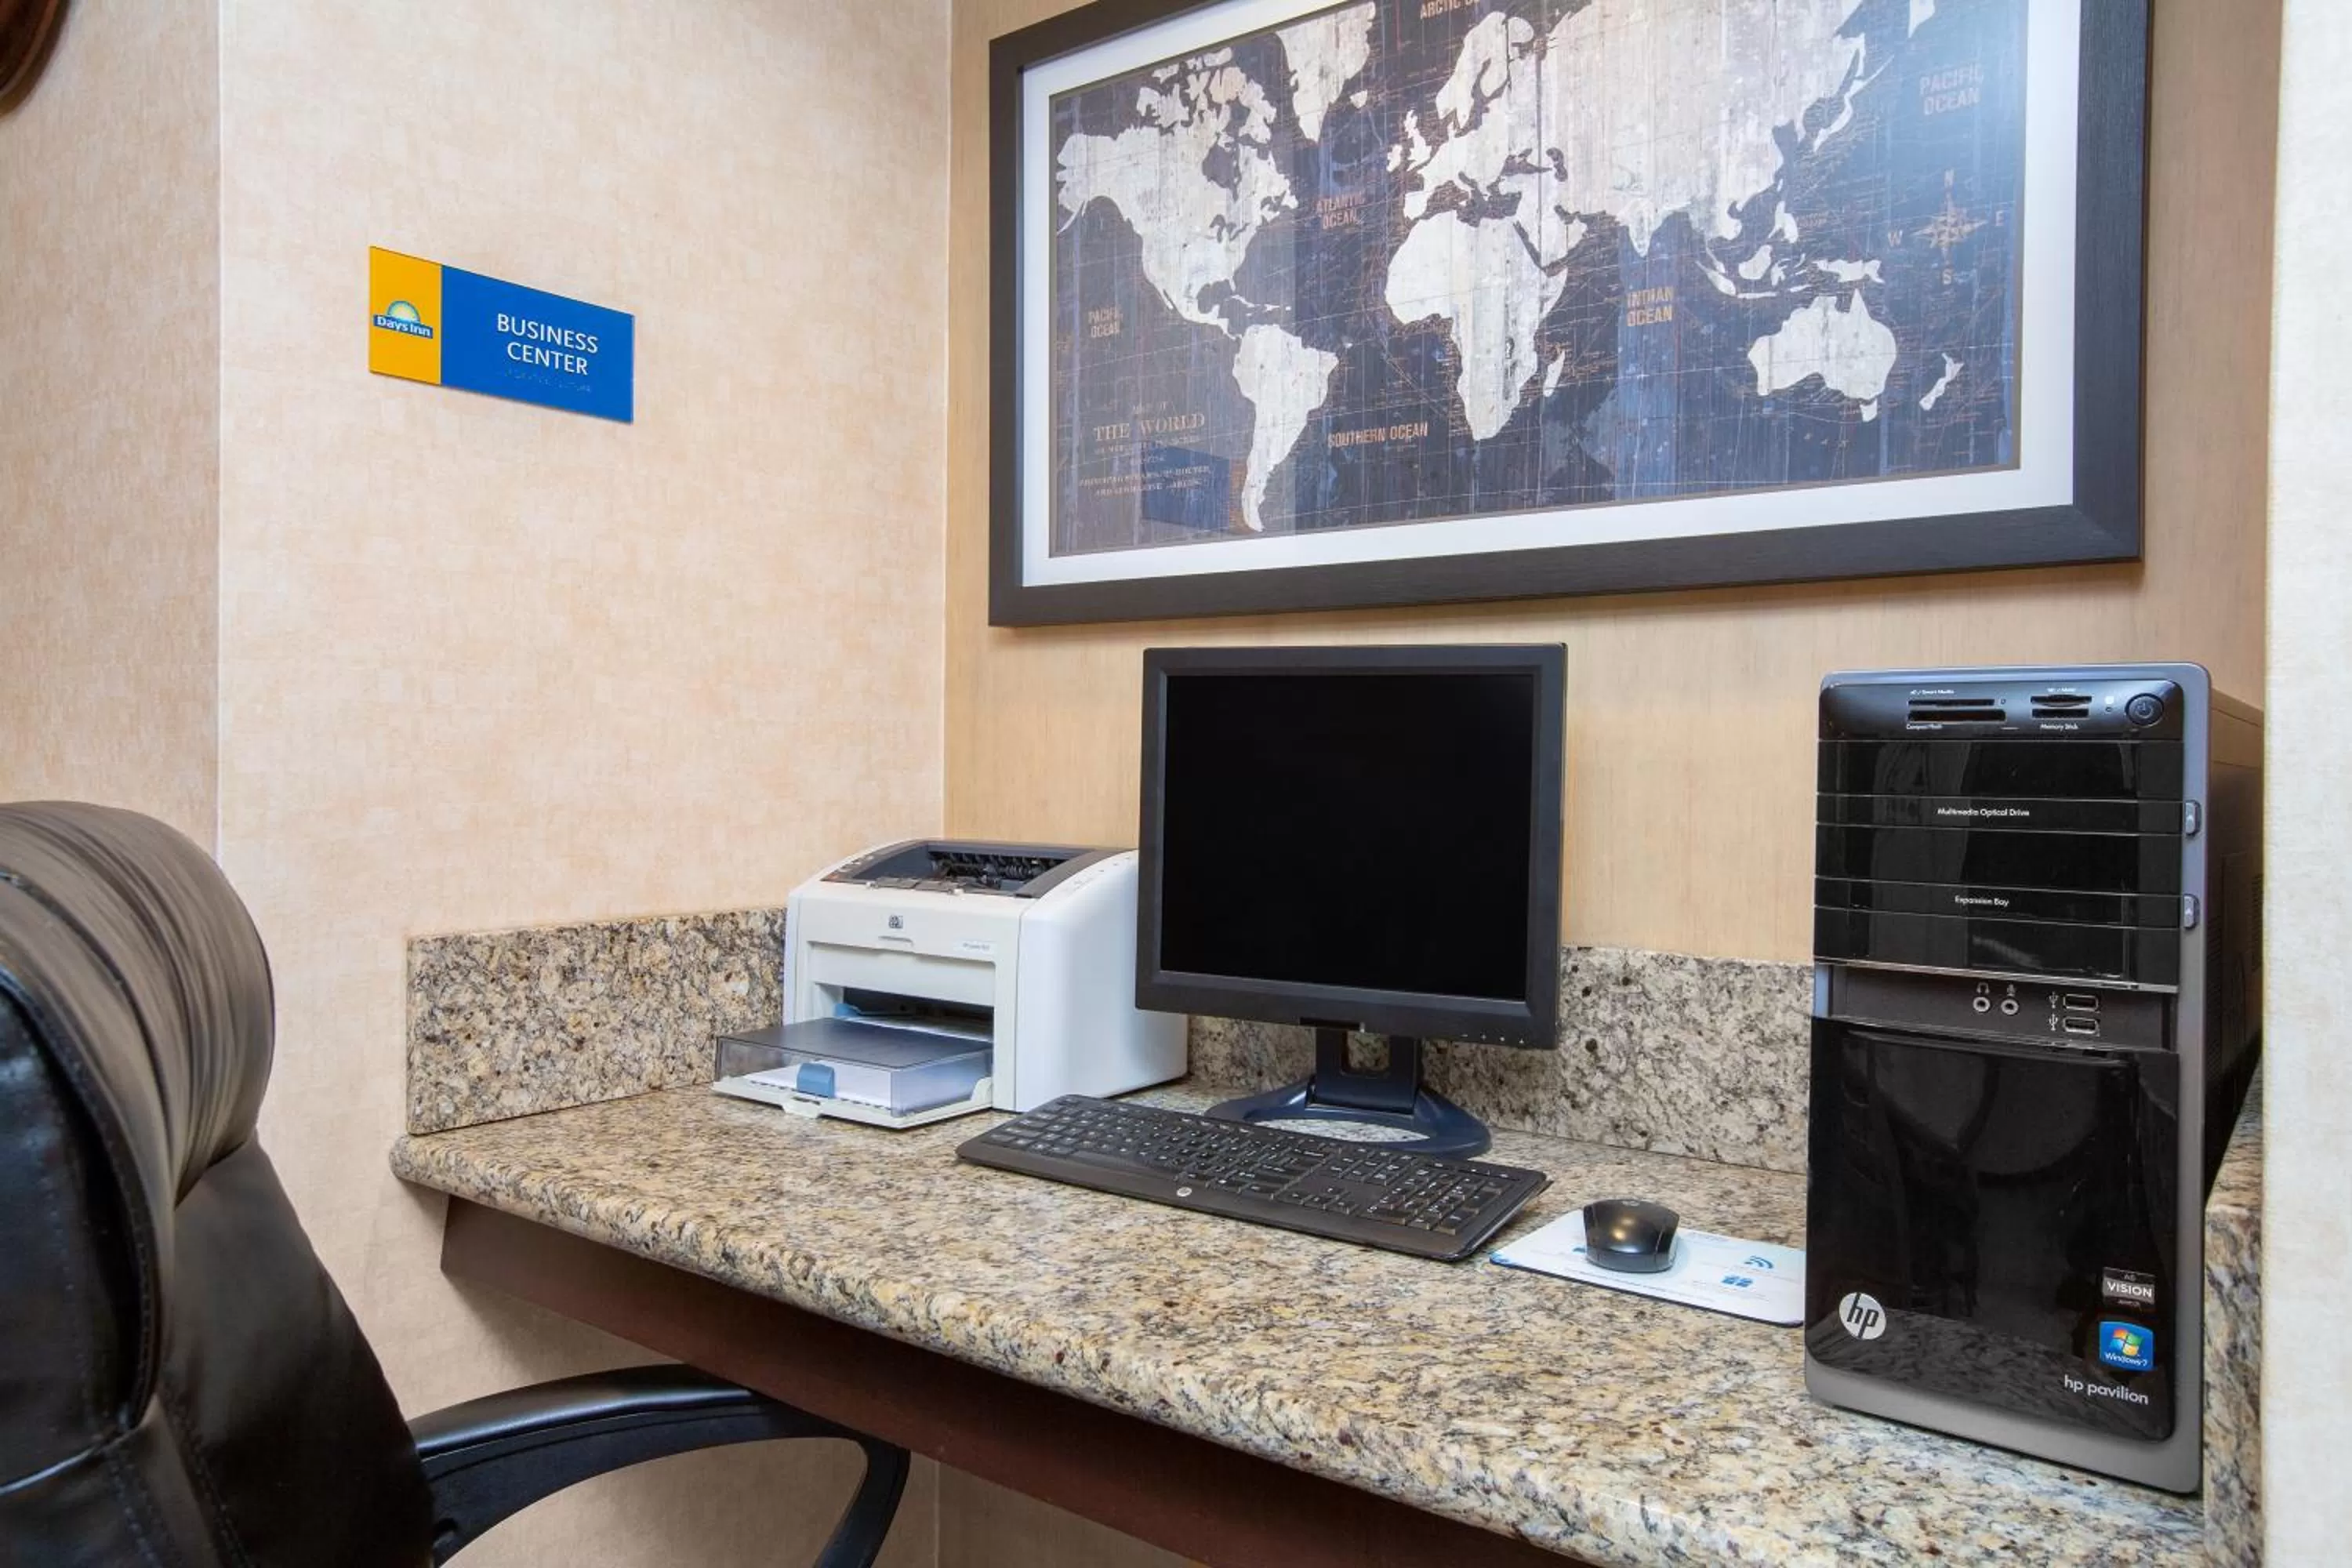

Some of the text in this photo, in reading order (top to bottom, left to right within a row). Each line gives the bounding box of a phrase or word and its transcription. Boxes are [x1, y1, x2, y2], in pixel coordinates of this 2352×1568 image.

[1923, 87, 1980, 115] OCEAN
[377, 316, 431, 337] Days Inn
[1626, 303, 1673, 327] OCEAN
[496, 313, 599, 354] BUSINESS
[506, 341, 588, 376] CENTER
[1094, 412, 1205, 442] THE WORLD
[1327, 420, 1428, 448] SOUTHERN OCEAN
[1937, 807, 1979, 816] Multimedia
[1980, 808, 2008, 818] Optical
[1994, 897, 2009, 908] Bay
[2107, 1280, 2152, 1298] VISION
[1846, 1292, 1879, 1340] hp
[2104, 1352, 2141, 1366] Windows
[2063, 1374, 2149, 1406] hp pavilion
